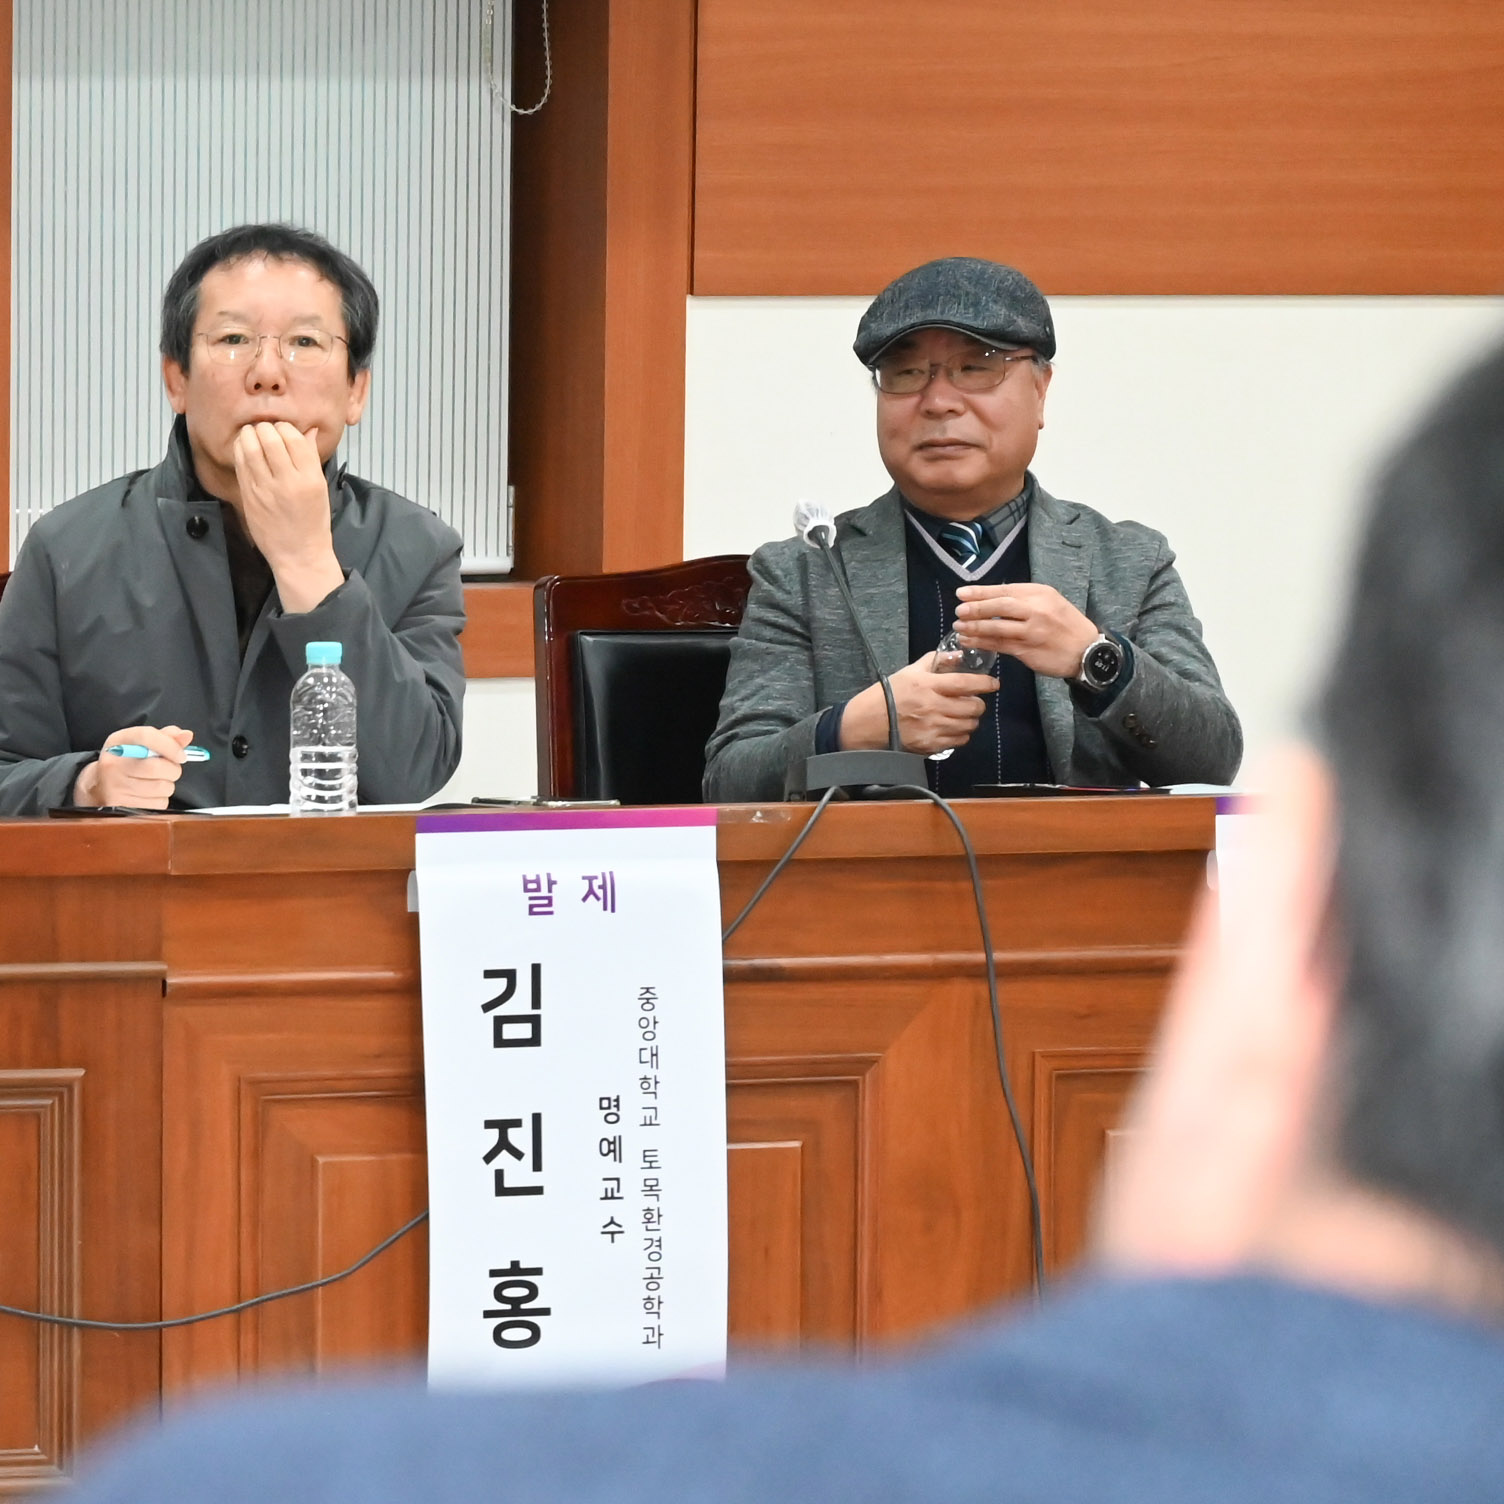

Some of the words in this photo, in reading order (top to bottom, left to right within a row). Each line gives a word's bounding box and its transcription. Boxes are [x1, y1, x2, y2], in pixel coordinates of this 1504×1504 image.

[522, 870, 616, 917] 발제
[637, 986, 661, 1128] 중앙대학교
[480, 962, 552, 1350] 김진홍
[598, 1094, 625, 1244] 명예교수
[639, 1148, 665, 1350] 토목환경공학과
